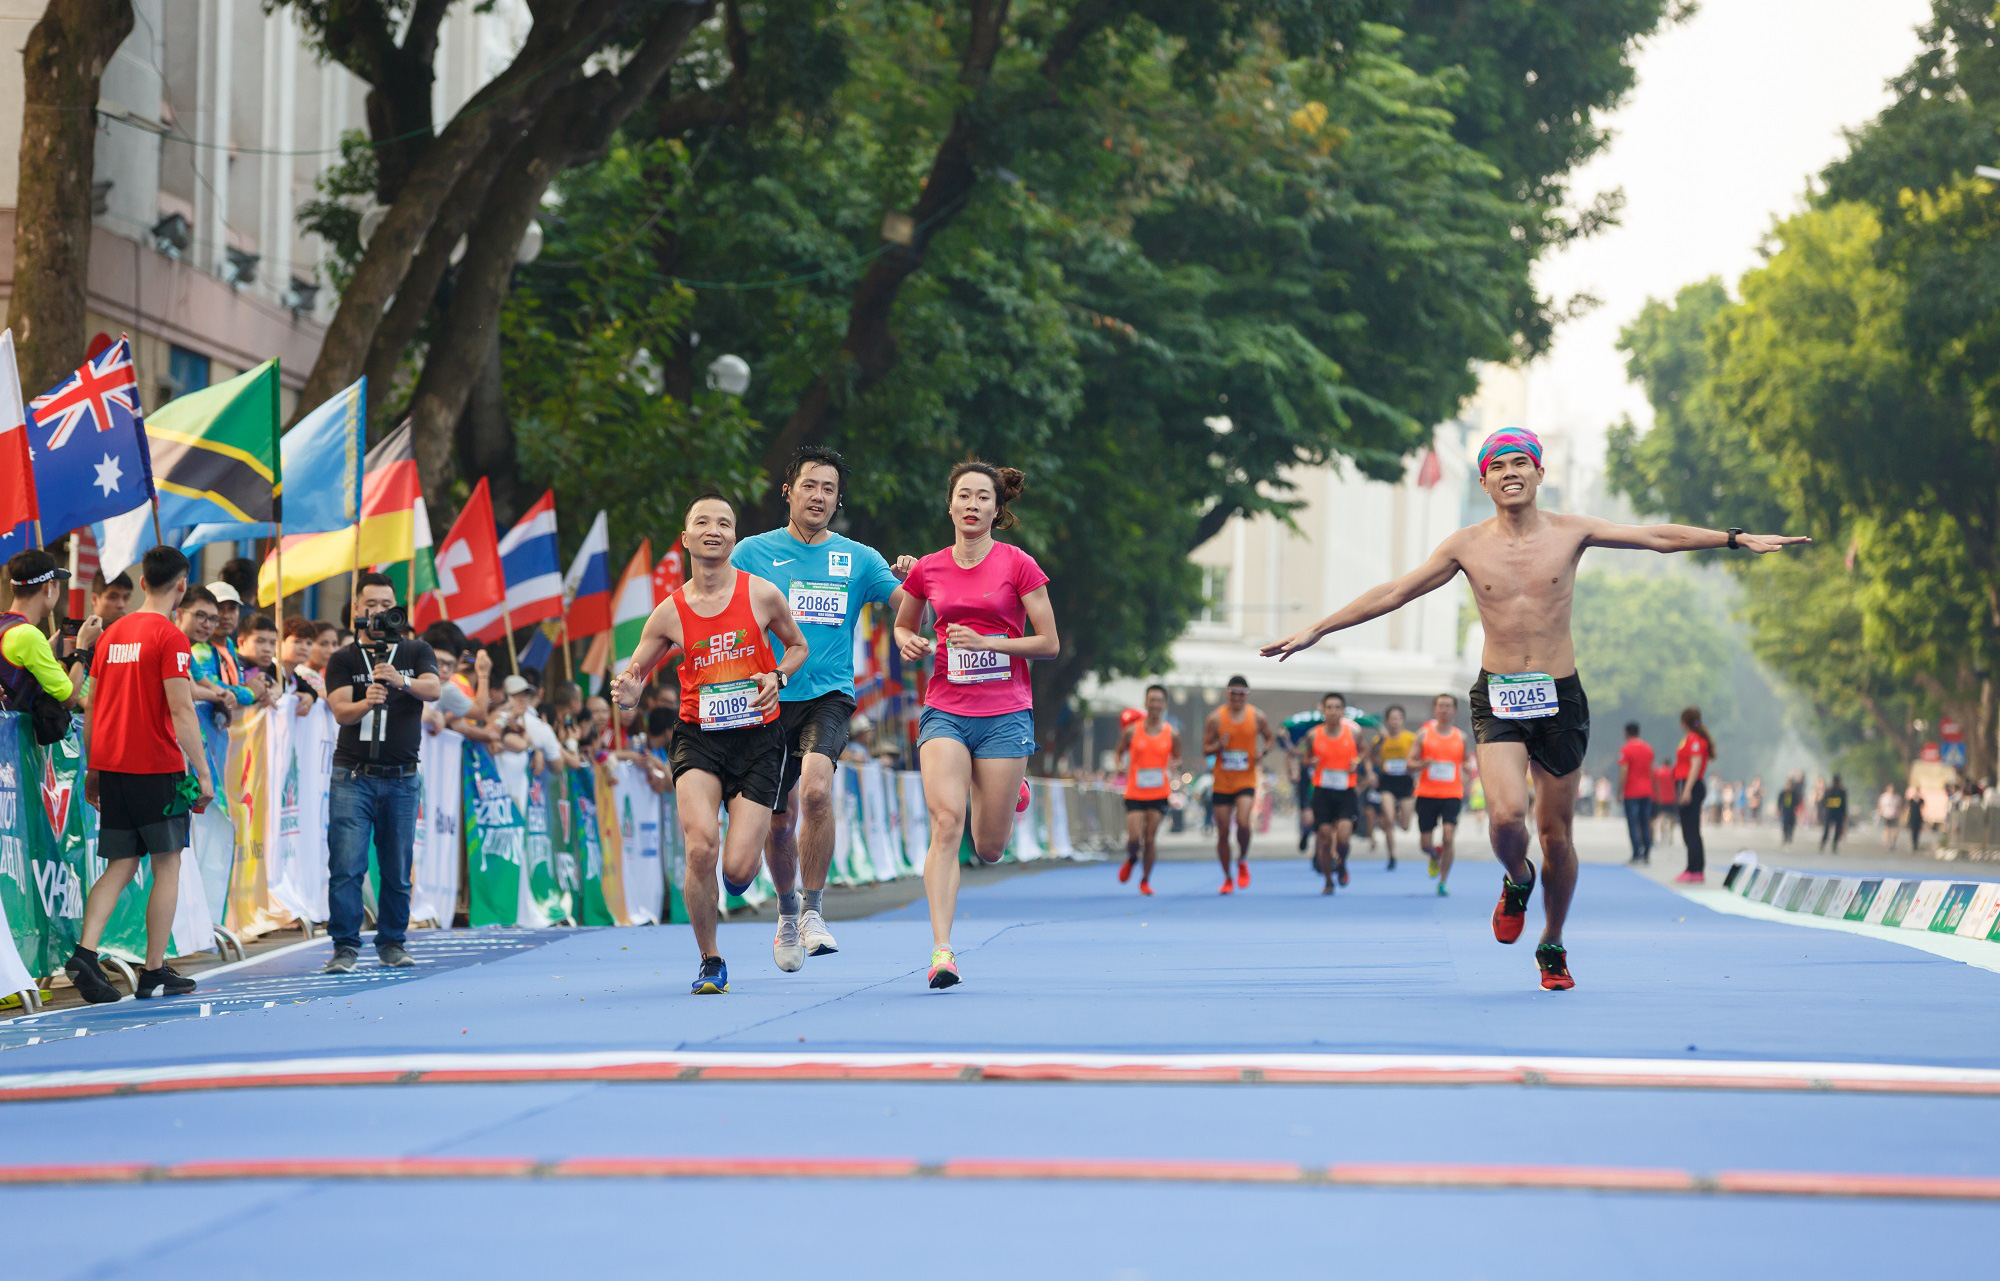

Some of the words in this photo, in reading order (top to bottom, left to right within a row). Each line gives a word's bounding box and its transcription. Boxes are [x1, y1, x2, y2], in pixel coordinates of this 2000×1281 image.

[797, 595, 839, 612] 20865
[709, 631, 737, 653] 98
[107, 642, 141, 664] JOHAN
[694, 645, 755, 670] Runners
[958, 651, 997, 669] 10268
[352, 674, 366, 683] THE
[708, 696, 748, 716] 20189
[1499, 687, 1546, 706] 20245
